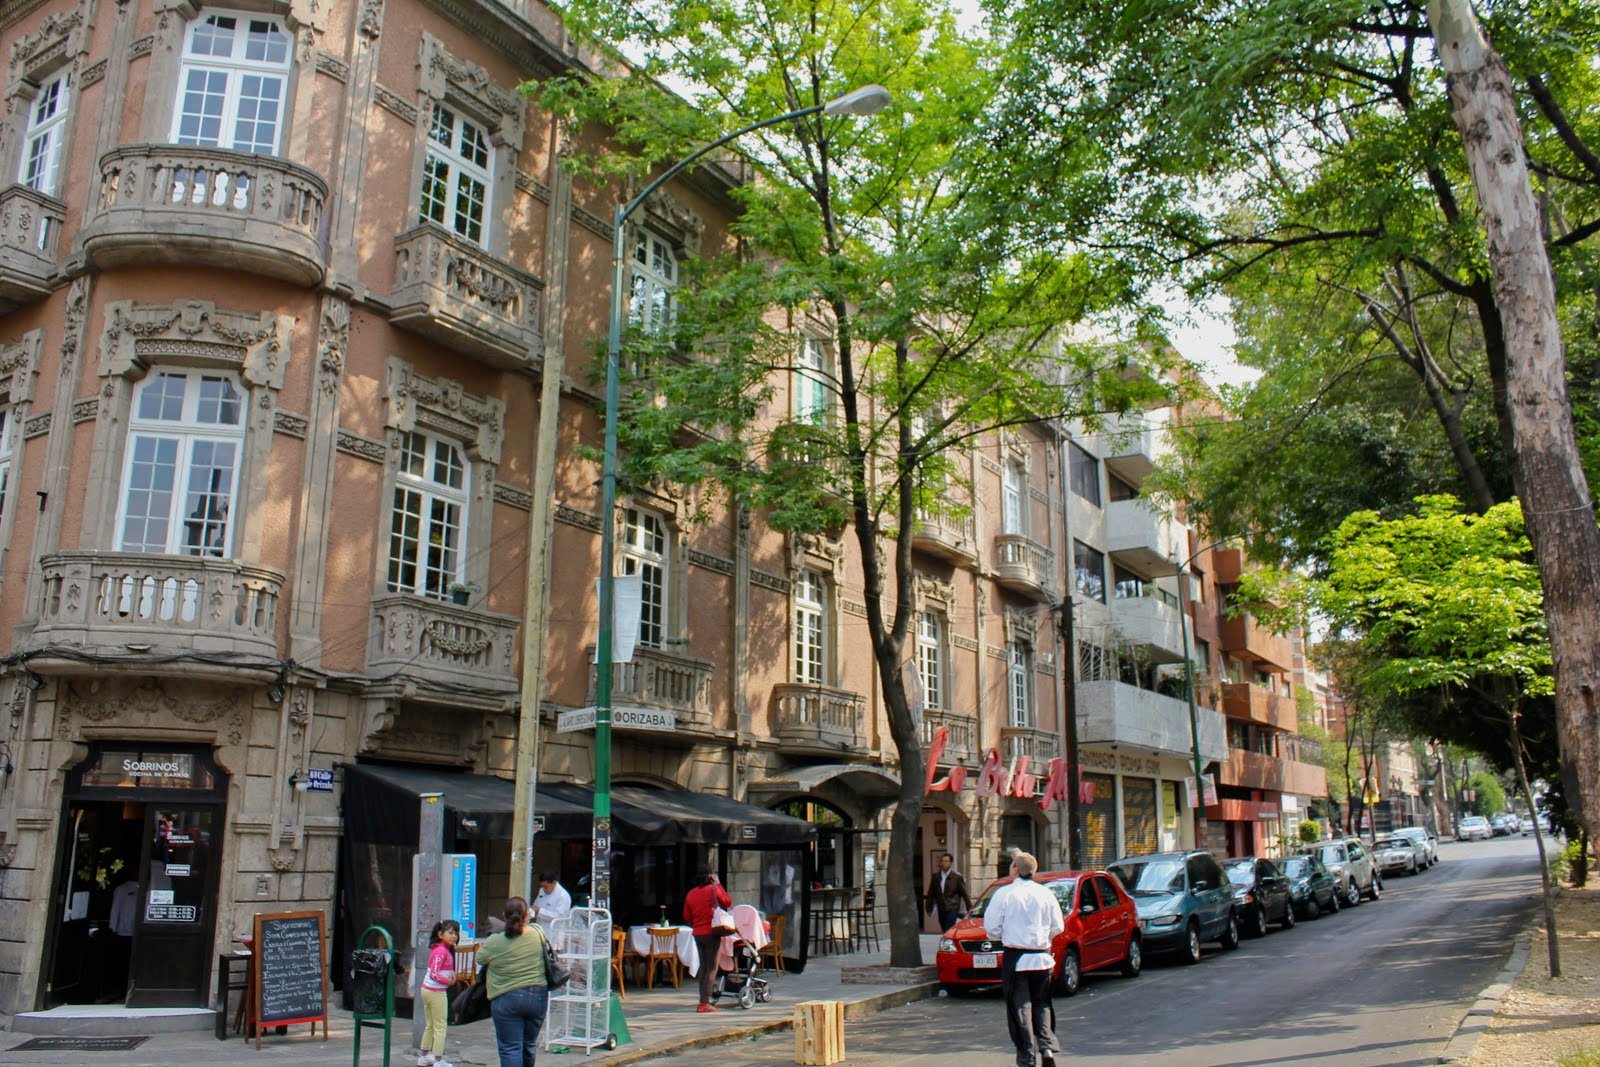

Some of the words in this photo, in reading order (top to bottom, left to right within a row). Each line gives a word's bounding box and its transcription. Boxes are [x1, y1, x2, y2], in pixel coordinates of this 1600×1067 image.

[622, 712, 666, 726] ORIZABA
[123, 759, 179, 772] SOBRINOS
[926, 727, 967, 796] La
[462, 862, 471, 920] infinitum
